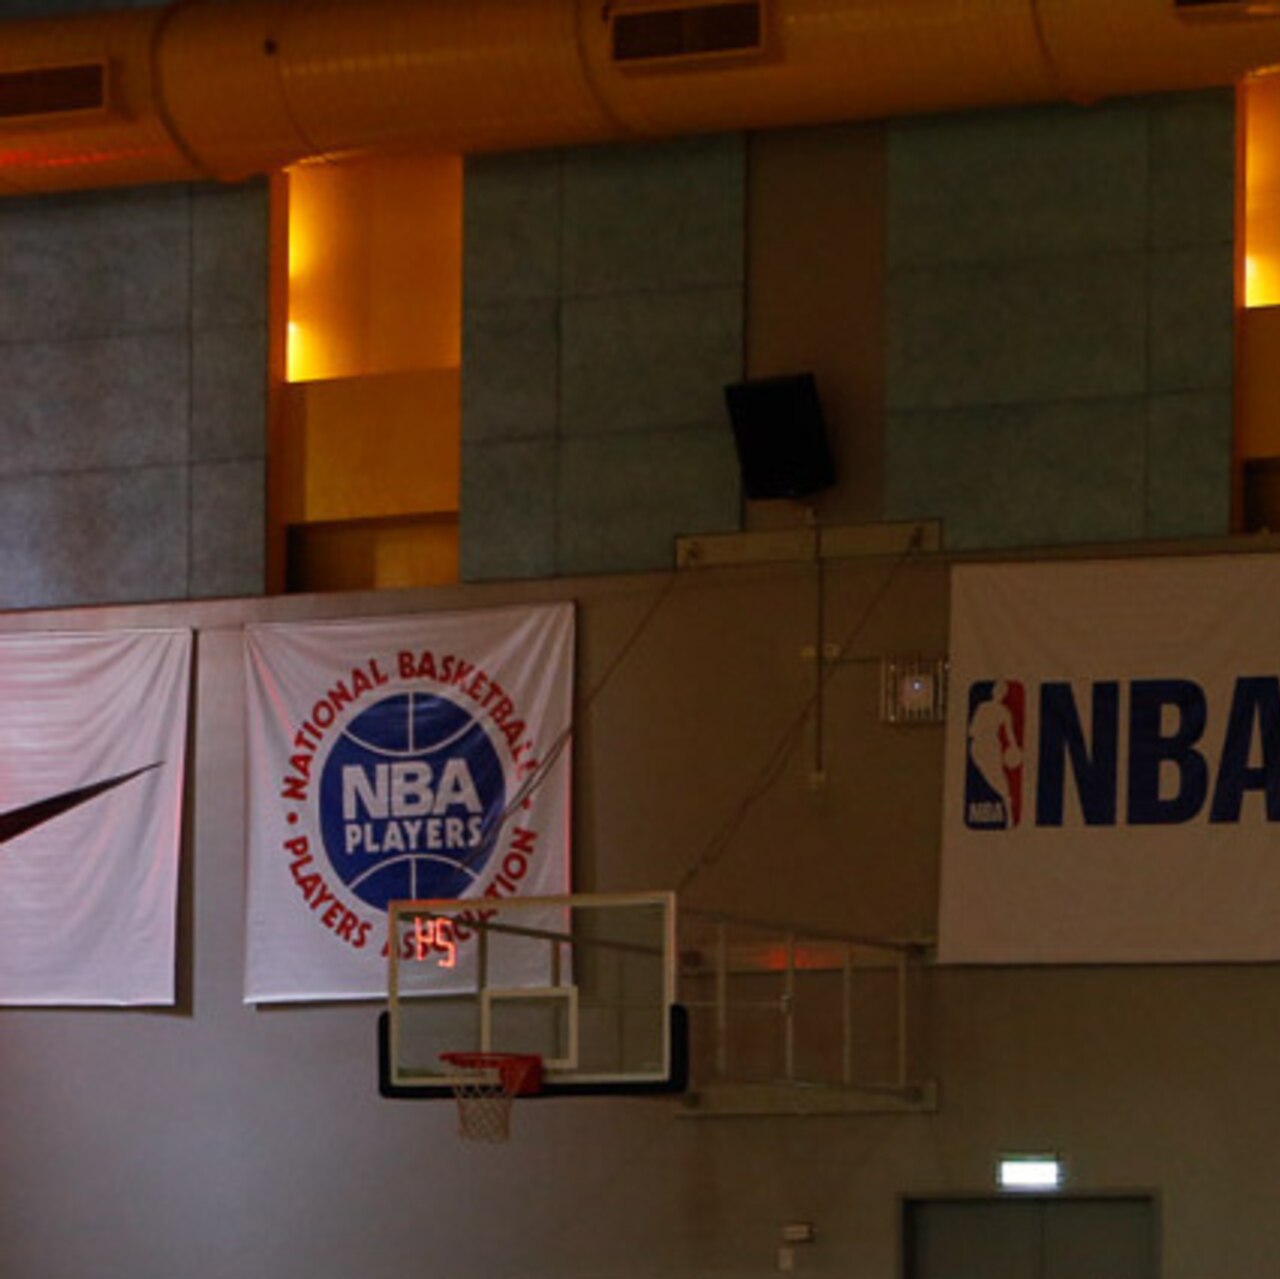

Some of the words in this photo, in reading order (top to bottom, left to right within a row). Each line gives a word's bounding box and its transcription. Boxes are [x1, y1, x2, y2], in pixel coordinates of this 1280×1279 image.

[281, 659, 389, 800] NATIONAL
[341, 757, 484, 820] NBA
[345, 815, 485, 854] PLAYERS
[283, 836, 373, 948] PLAYERS
